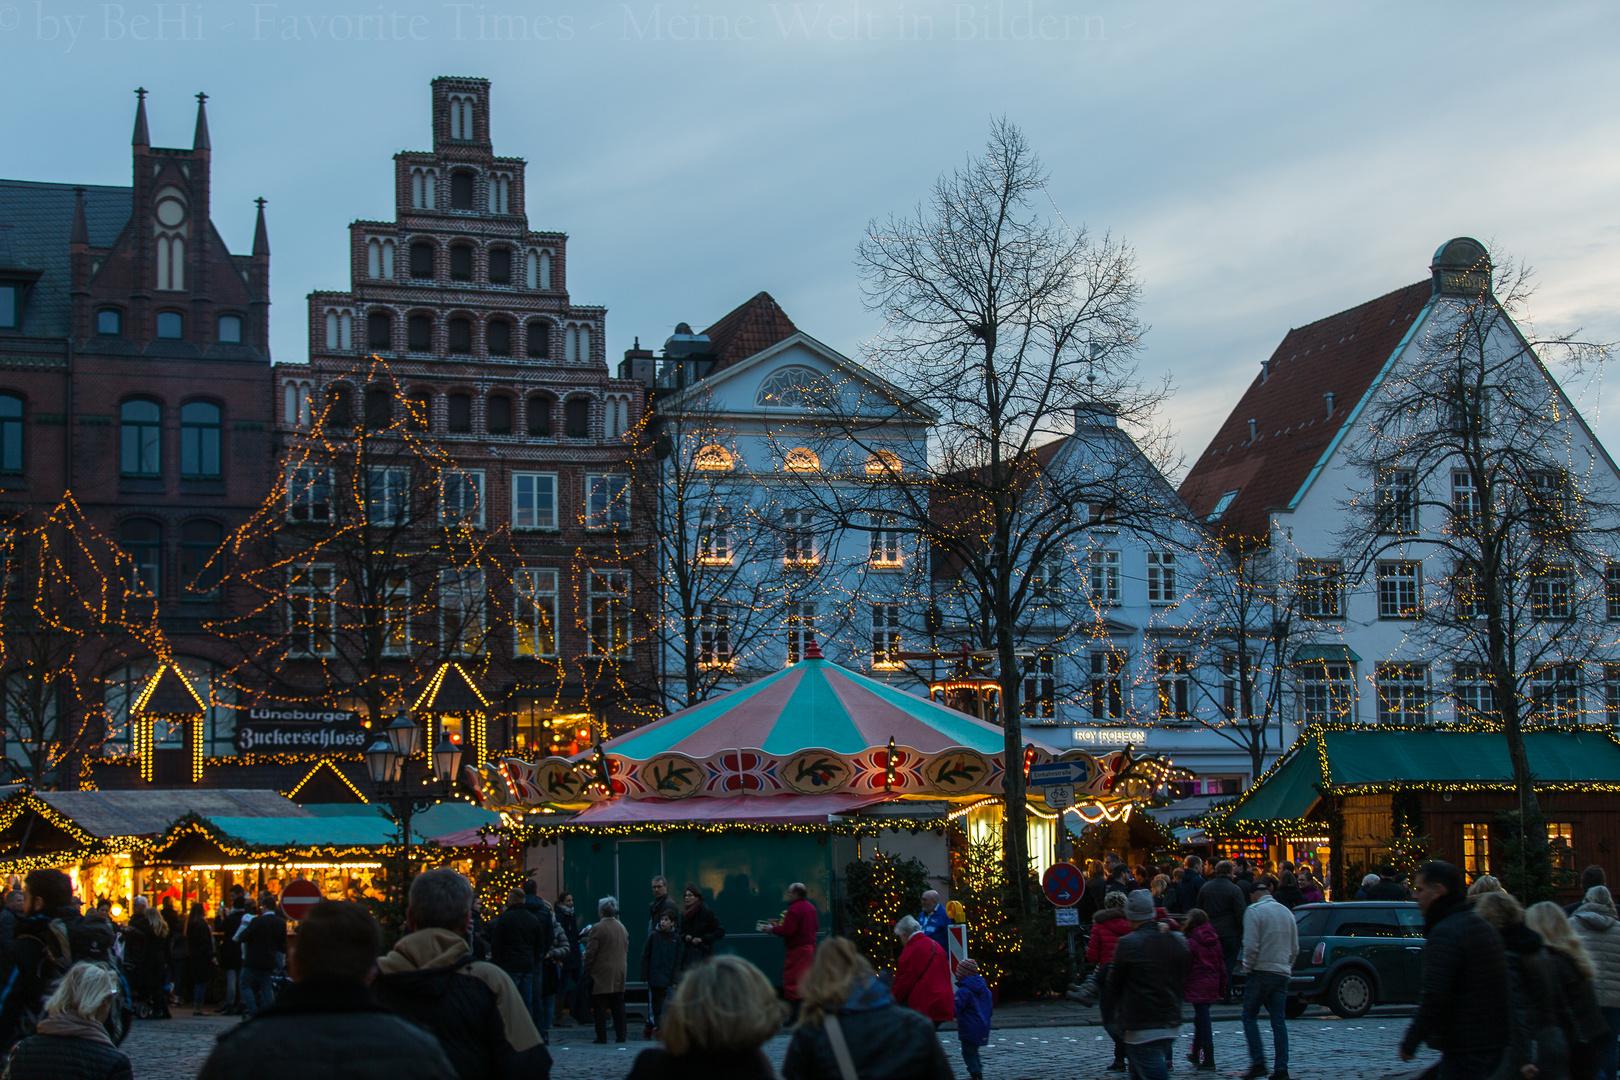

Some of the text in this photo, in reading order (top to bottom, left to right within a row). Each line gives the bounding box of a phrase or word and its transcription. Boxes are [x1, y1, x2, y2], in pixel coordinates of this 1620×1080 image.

[250, 709, 353, 722] Lüneburger
[239, 727, 366, 749] Zuckerschloss
[1075, 730, 1146, 741] ROY ROBSON
[1034, 769, 1071, 778] Einbahnstraße
